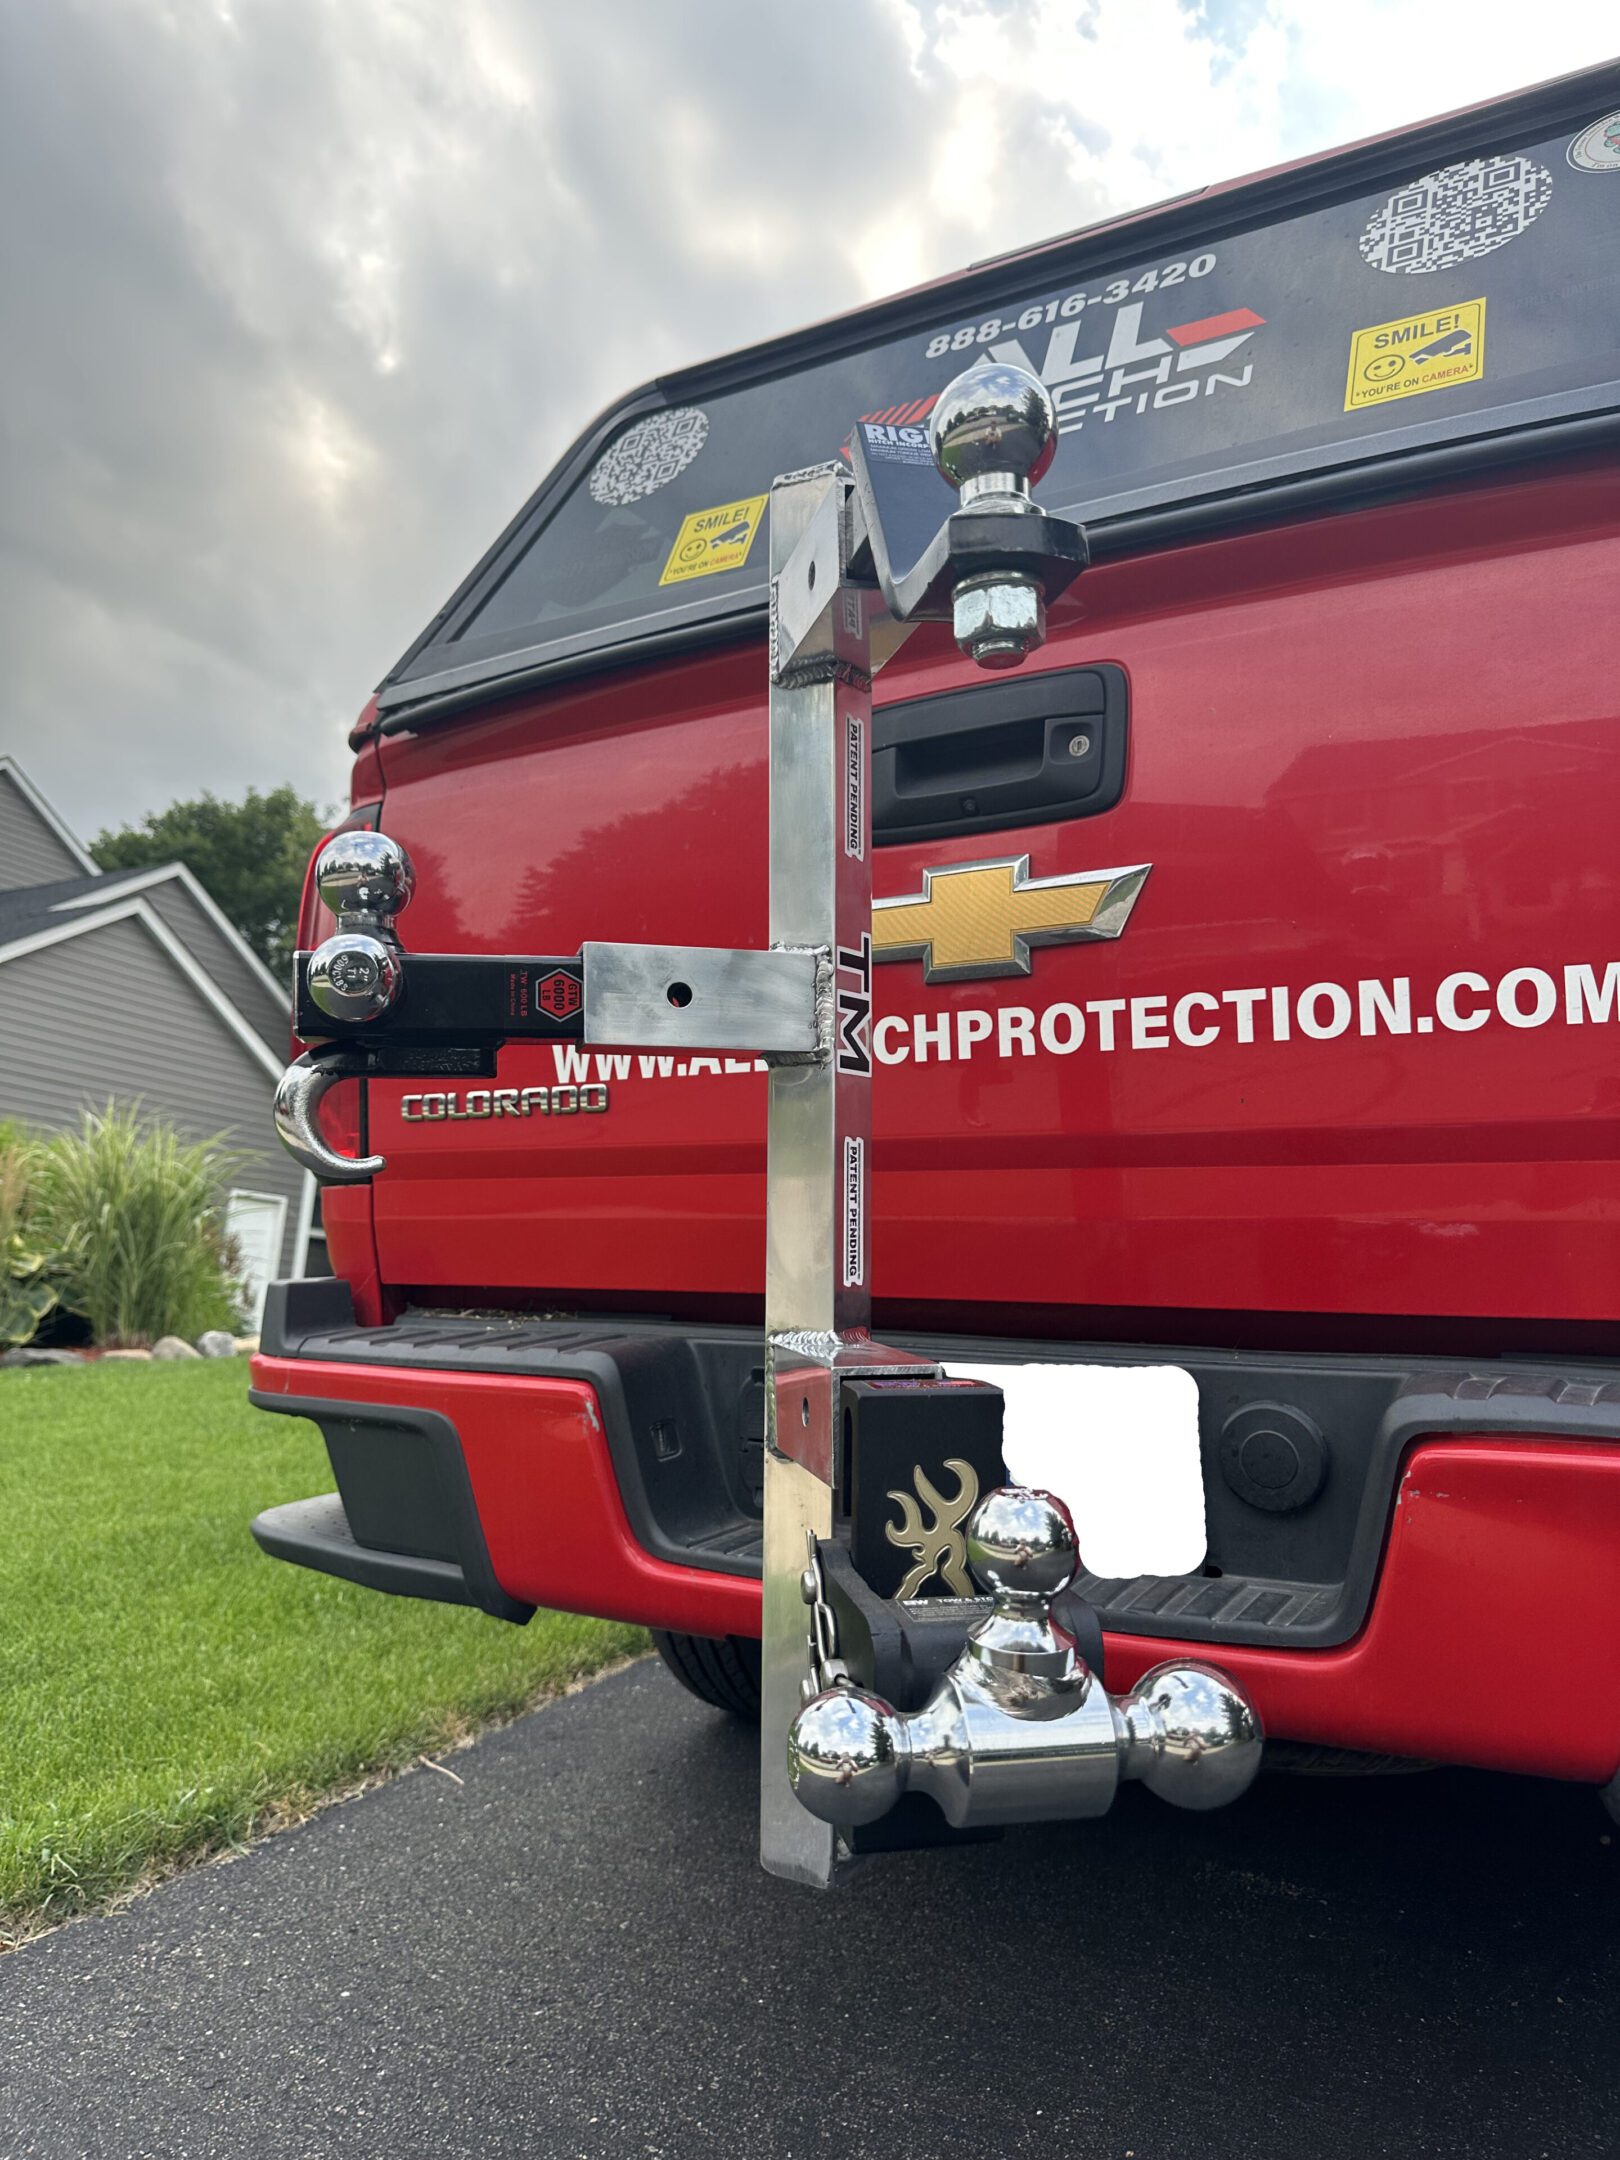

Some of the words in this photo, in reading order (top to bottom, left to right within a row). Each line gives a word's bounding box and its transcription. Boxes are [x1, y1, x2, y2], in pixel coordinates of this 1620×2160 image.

[925, 253, 1217, 359] 888-616-3420
[1373, 313, 1460, 350] SMILE!
[1403, 377, 1420, 389] ON
[896, 441, 929, 449] INCORP
[693, 506, 750, 534] SMILE!
[849, 723, 858, 781] PATENT
[849, 783, 858, 850] PENDING
[542, 989, 551, 1001] LB
[553, 979, 565, 1011] 6000
[567, 983, 578, 1006] GTW
[837, 931, 872, 1078] TM
[872, 961, 1620, 1066] CHPROTECTION.COM
[400, 1082, 609, 1123] COLORADO
[849, 1146, 858, 1204] PATENT
[849, 1207, 858, 1277] PENDING
